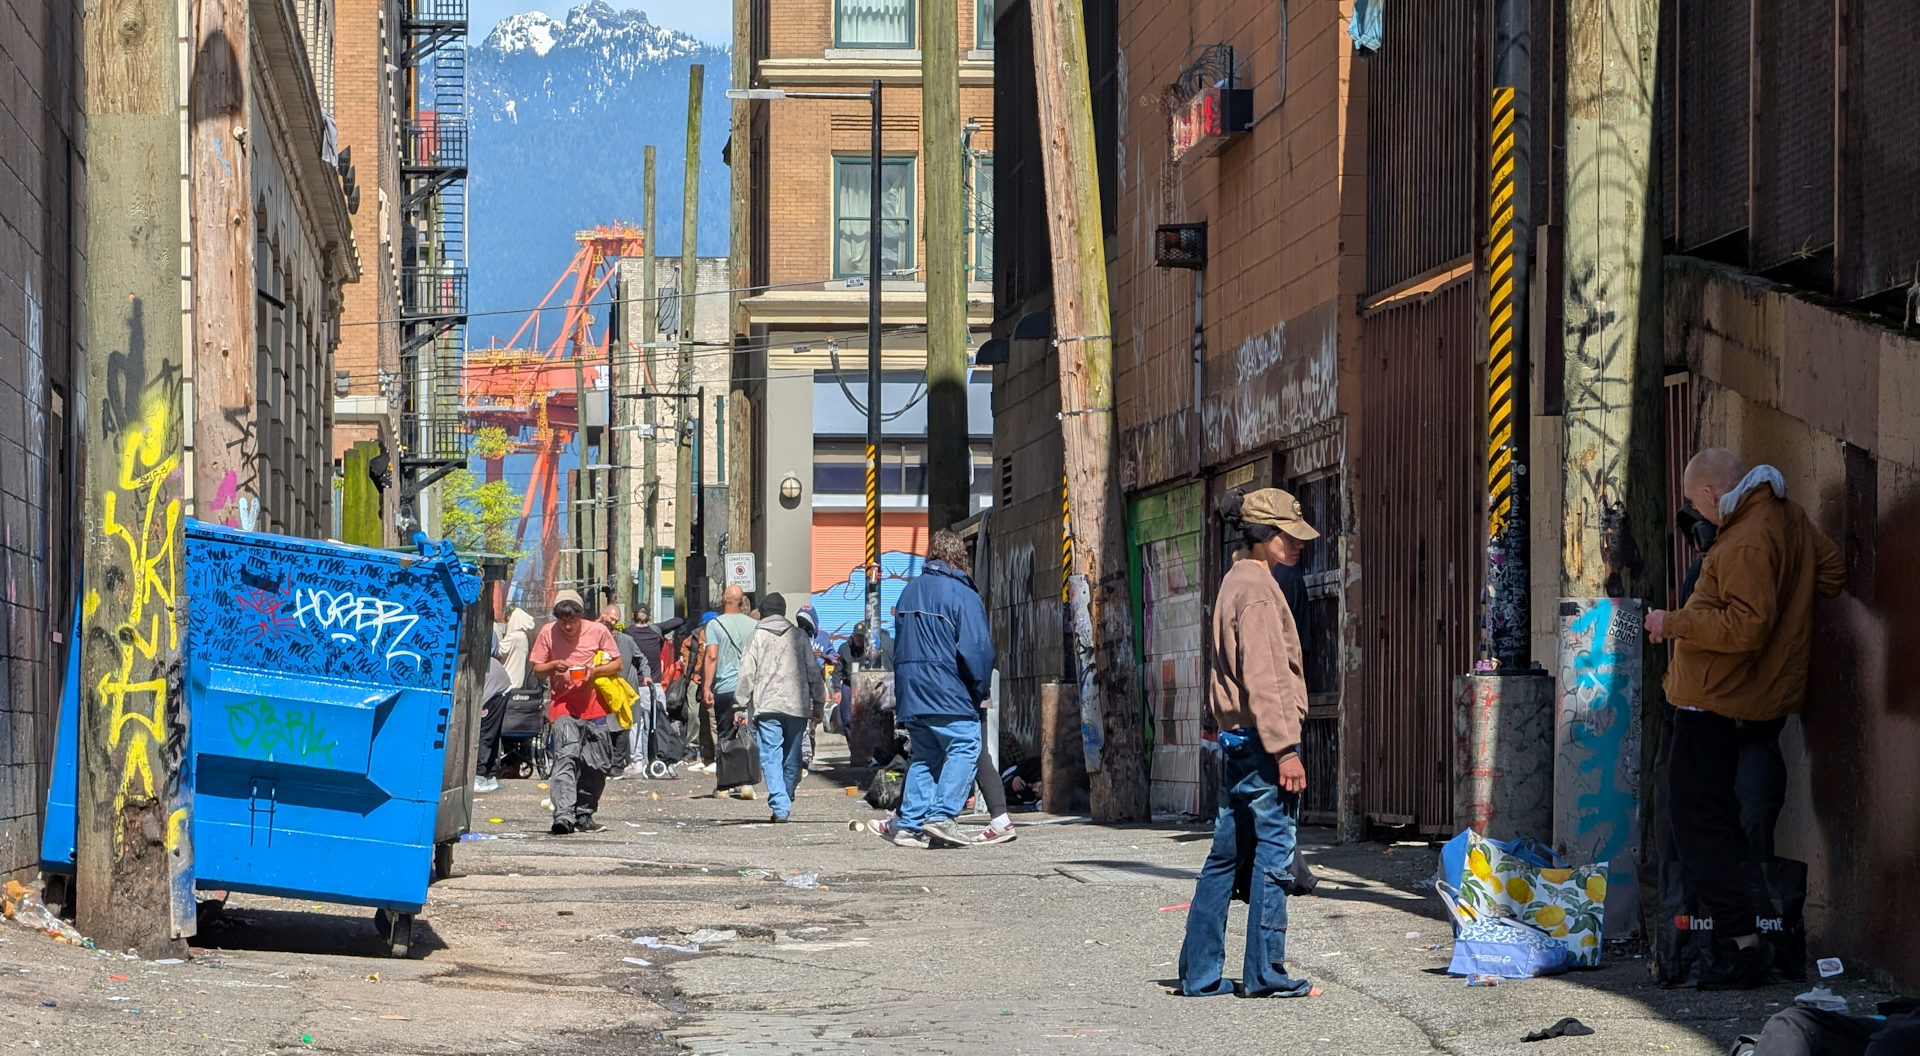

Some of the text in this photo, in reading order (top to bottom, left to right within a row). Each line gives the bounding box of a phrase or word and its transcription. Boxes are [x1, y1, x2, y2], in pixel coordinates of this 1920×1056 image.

[1615, 609, 1641, 626] RESER
[1612, 617, 1639, 636] DMAC
[1608, 627, 1636, 644] DOUM
